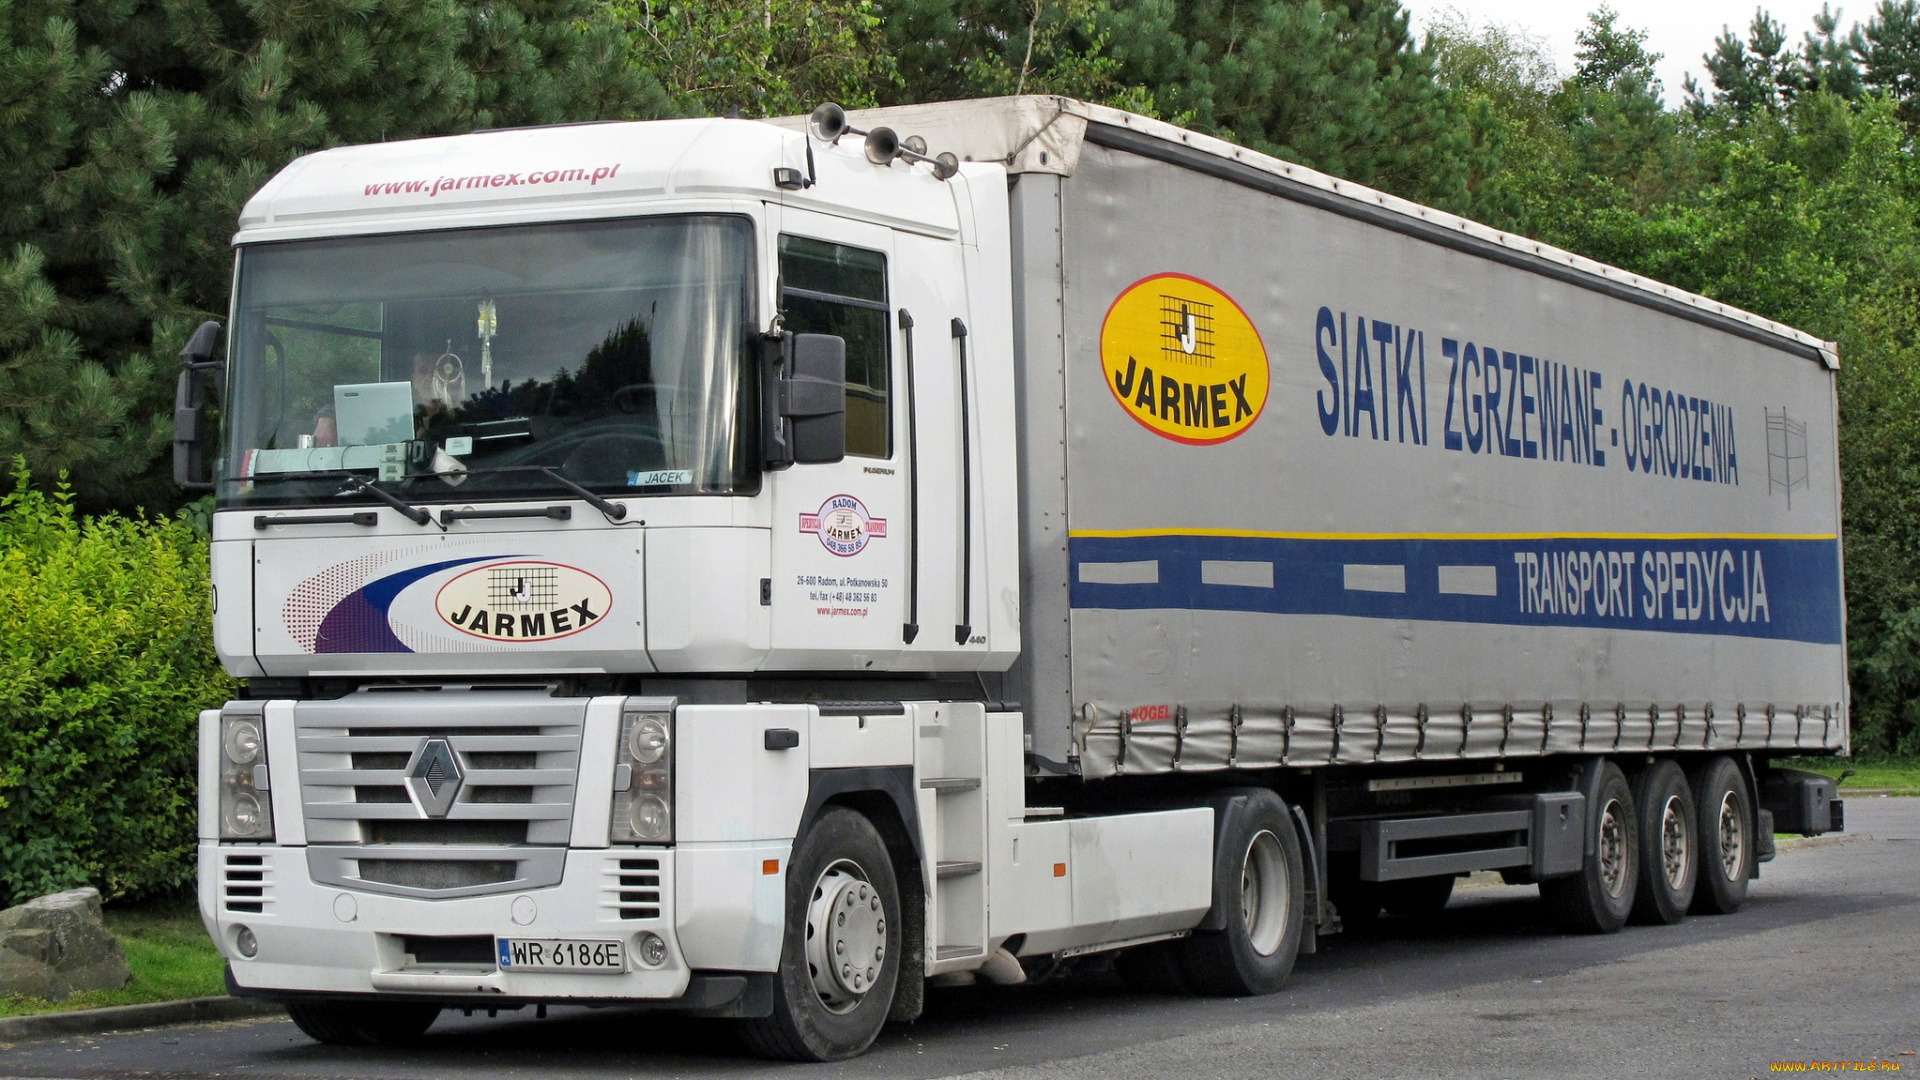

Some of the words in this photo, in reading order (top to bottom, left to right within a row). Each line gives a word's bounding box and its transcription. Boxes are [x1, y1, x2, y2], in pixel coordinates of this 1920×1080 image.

[363, 163, 621, 197] www.jarmex.com.pl
[1115, 355, 1254, 428] JARMEX
[1315, 305, 1428, 446] SIATKI
[1441, 337, 1606, 467] ZGRZEWANE
[1622, 378, 1739, 486] OGRODZENIA
[645, 472, 685, 485] JACEK
[832, 498, 857, 510] RADOM
[827, 525, 862, 540] JARMEX
[797, 575, 816, 586] 26-600
[818, 576, 838, 588] Radom,
[881, 578, 888, 588] 50
[1514, 551, 1635, 618] TRANSPORT
[1641, 550, 1771, 623] SPEDYCJA
[451, 597, 598, 637] JARMEX
[817, 605, 868, 618] www.jarmex.com.pl
[512, 942, 544, 965] WR
[552, 943, 620, 966] 6186E
